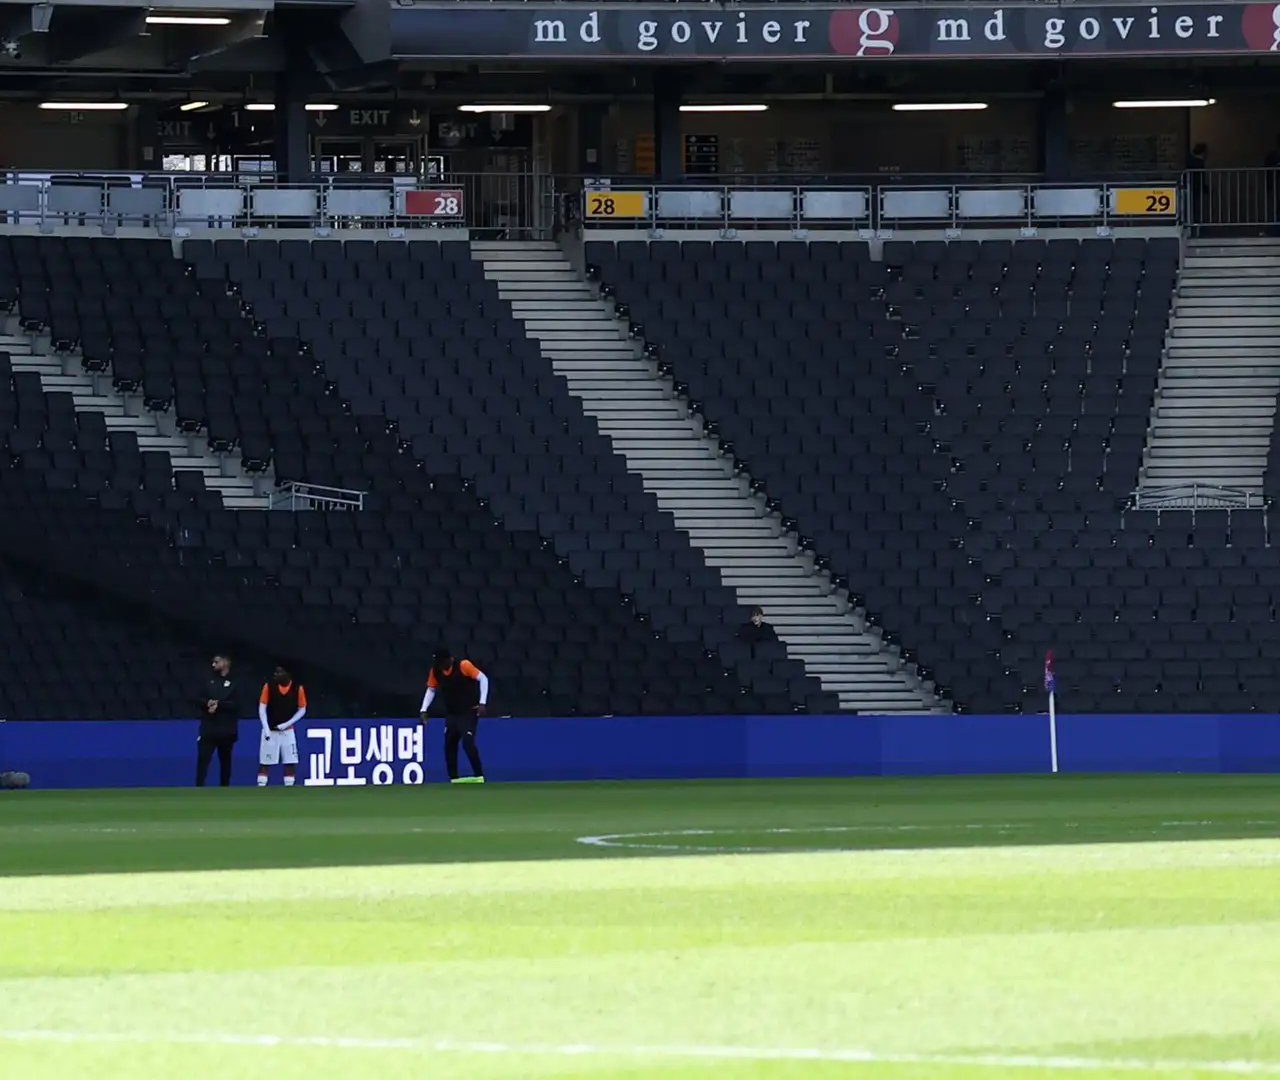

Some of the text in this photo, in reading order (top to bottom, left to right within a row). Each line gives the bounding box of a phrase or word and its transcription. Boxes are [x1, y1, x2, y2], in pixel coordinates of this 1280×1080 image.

[534, 11, 810, 51] md govier
[857, 8, 894, 57] g
[937, 10, 1006, 41] md
[1044, 7, 1223, 49] govier
[350, 109, 390, 126] EXIT
[438, 122, 478, 138] EXIT
[434, 196, 458, 214] 28
[592, 198, 614, 214] 28
[1146, 195, 1170, 212] 29
[304, 724, 424, 786] 교보생명
